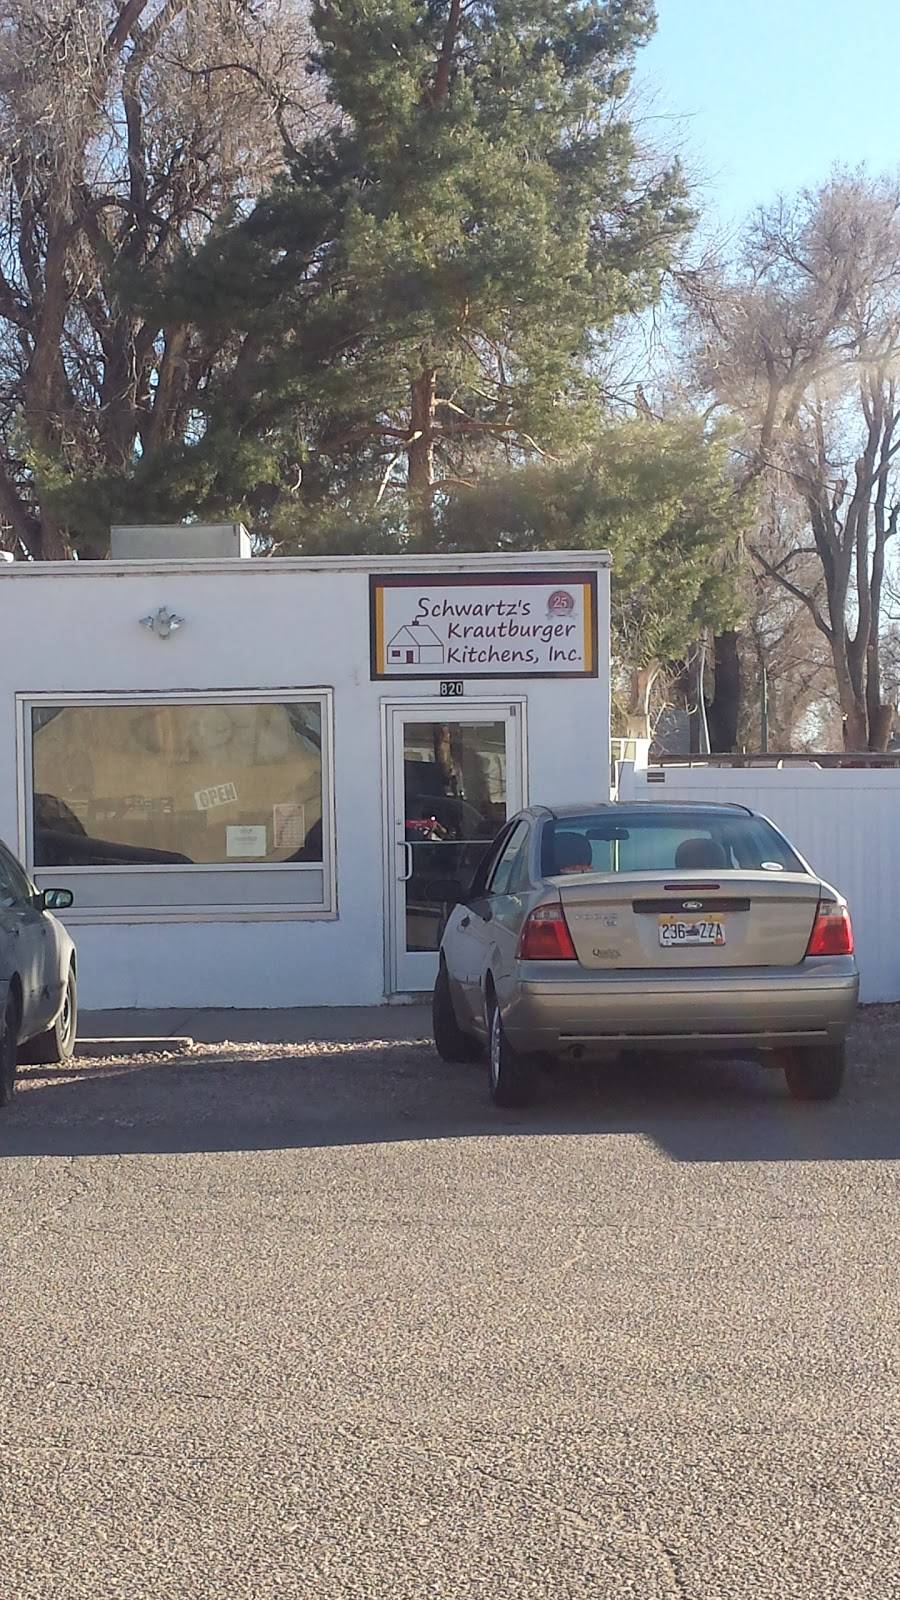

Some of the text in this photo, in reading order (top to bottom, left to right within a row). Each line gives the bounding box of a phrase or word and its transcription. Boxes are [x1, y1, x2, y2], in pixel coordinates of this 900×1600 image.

[418, 597, 531, 617] Schwartz's
[553, 596, 567, 608] 25
[448, 620, 576, 642] Krautburger
[447, 646, 582, 664] Kitchens, Inc.
[440, 682, 463, 695] 820
[199, 783, 235, 807] OPEN
[662, 922, 723, 939] 236 ZZA
